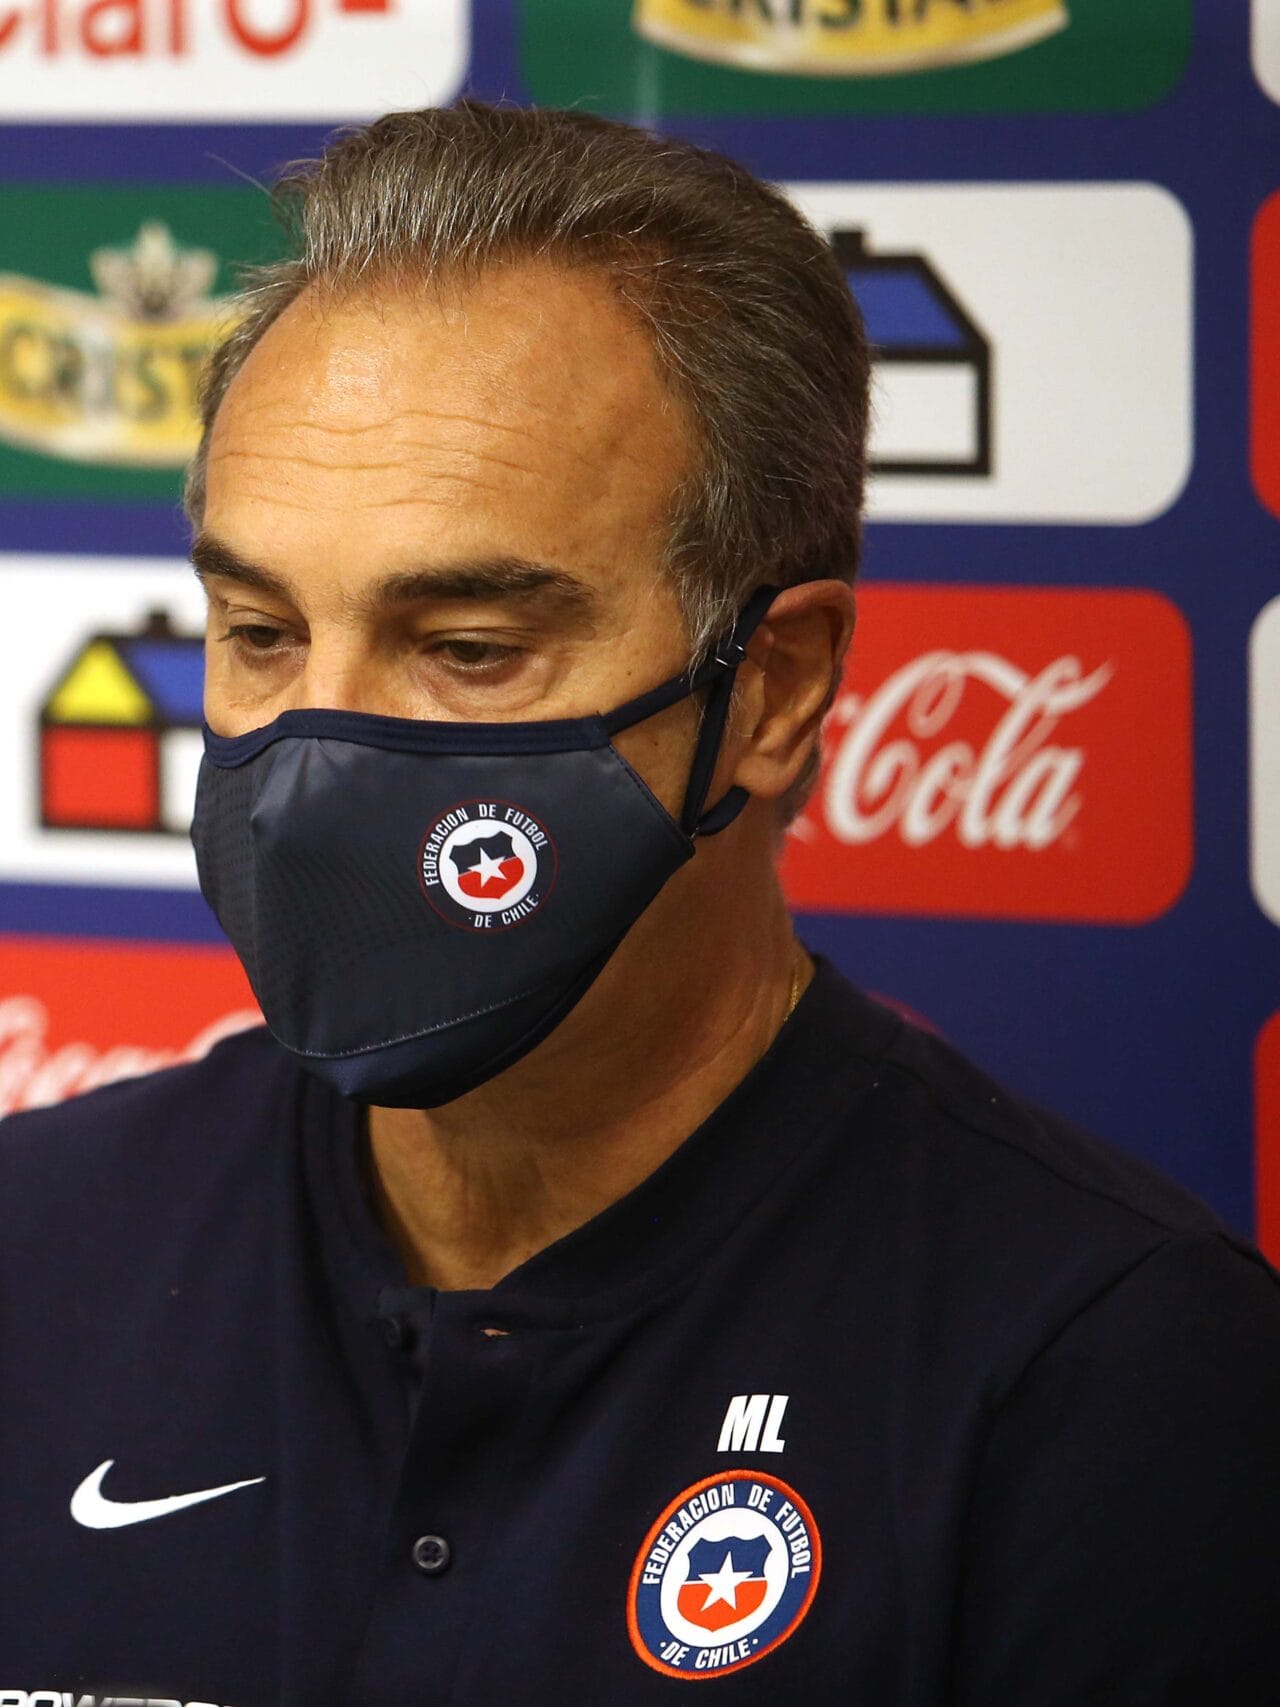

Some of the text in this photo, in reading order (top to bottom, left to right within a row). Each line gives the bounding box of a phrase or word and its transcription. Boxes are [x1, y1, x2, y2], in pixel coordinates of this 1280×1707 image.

[423, 803, 549, 887] FEDERACION DE FUTBOL
[474, 895, 539, 928] DE CHILE
[717, 1394, 789, 1453] ML
[642, 1483, 811, 1585] FEDERACION DE FUTBOL
[660, 1639, 751, 1670] DE CHILE
